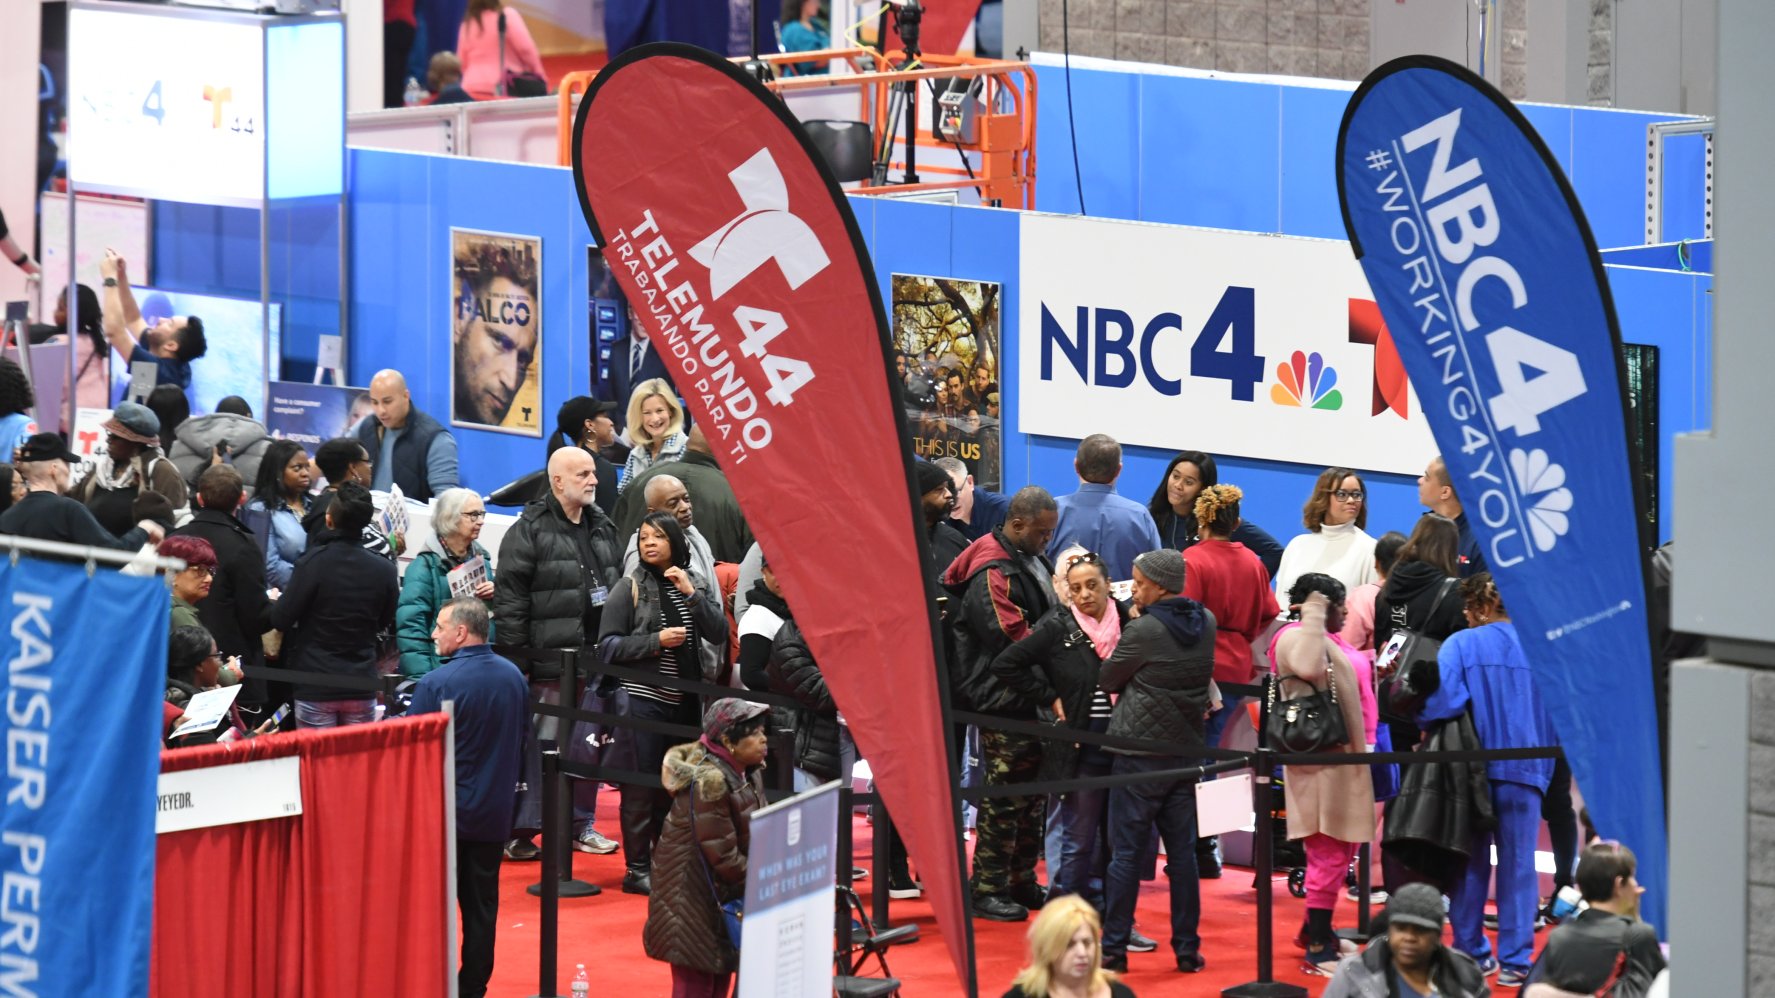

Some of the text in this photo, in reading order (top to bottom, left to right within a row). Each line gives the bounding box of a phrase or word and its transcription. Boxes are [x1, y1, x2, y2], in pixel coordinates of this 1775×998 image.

[611, 228, 748, 464] TRABAJANDO PARA TI
[631, 209, 772, 449] TELEMUNDO
[732, 305, 815, 407] 44
[1365, 148, 1525, 568] #WORKING4YOU
[913, 437, 981, 460] THIS IS US
[7, 591, 54, 811] KAISER
[758, 844, 828, 881] WHEN WAS YOUR
[759, 866, 827, 901] LAST EYE EXAM?
